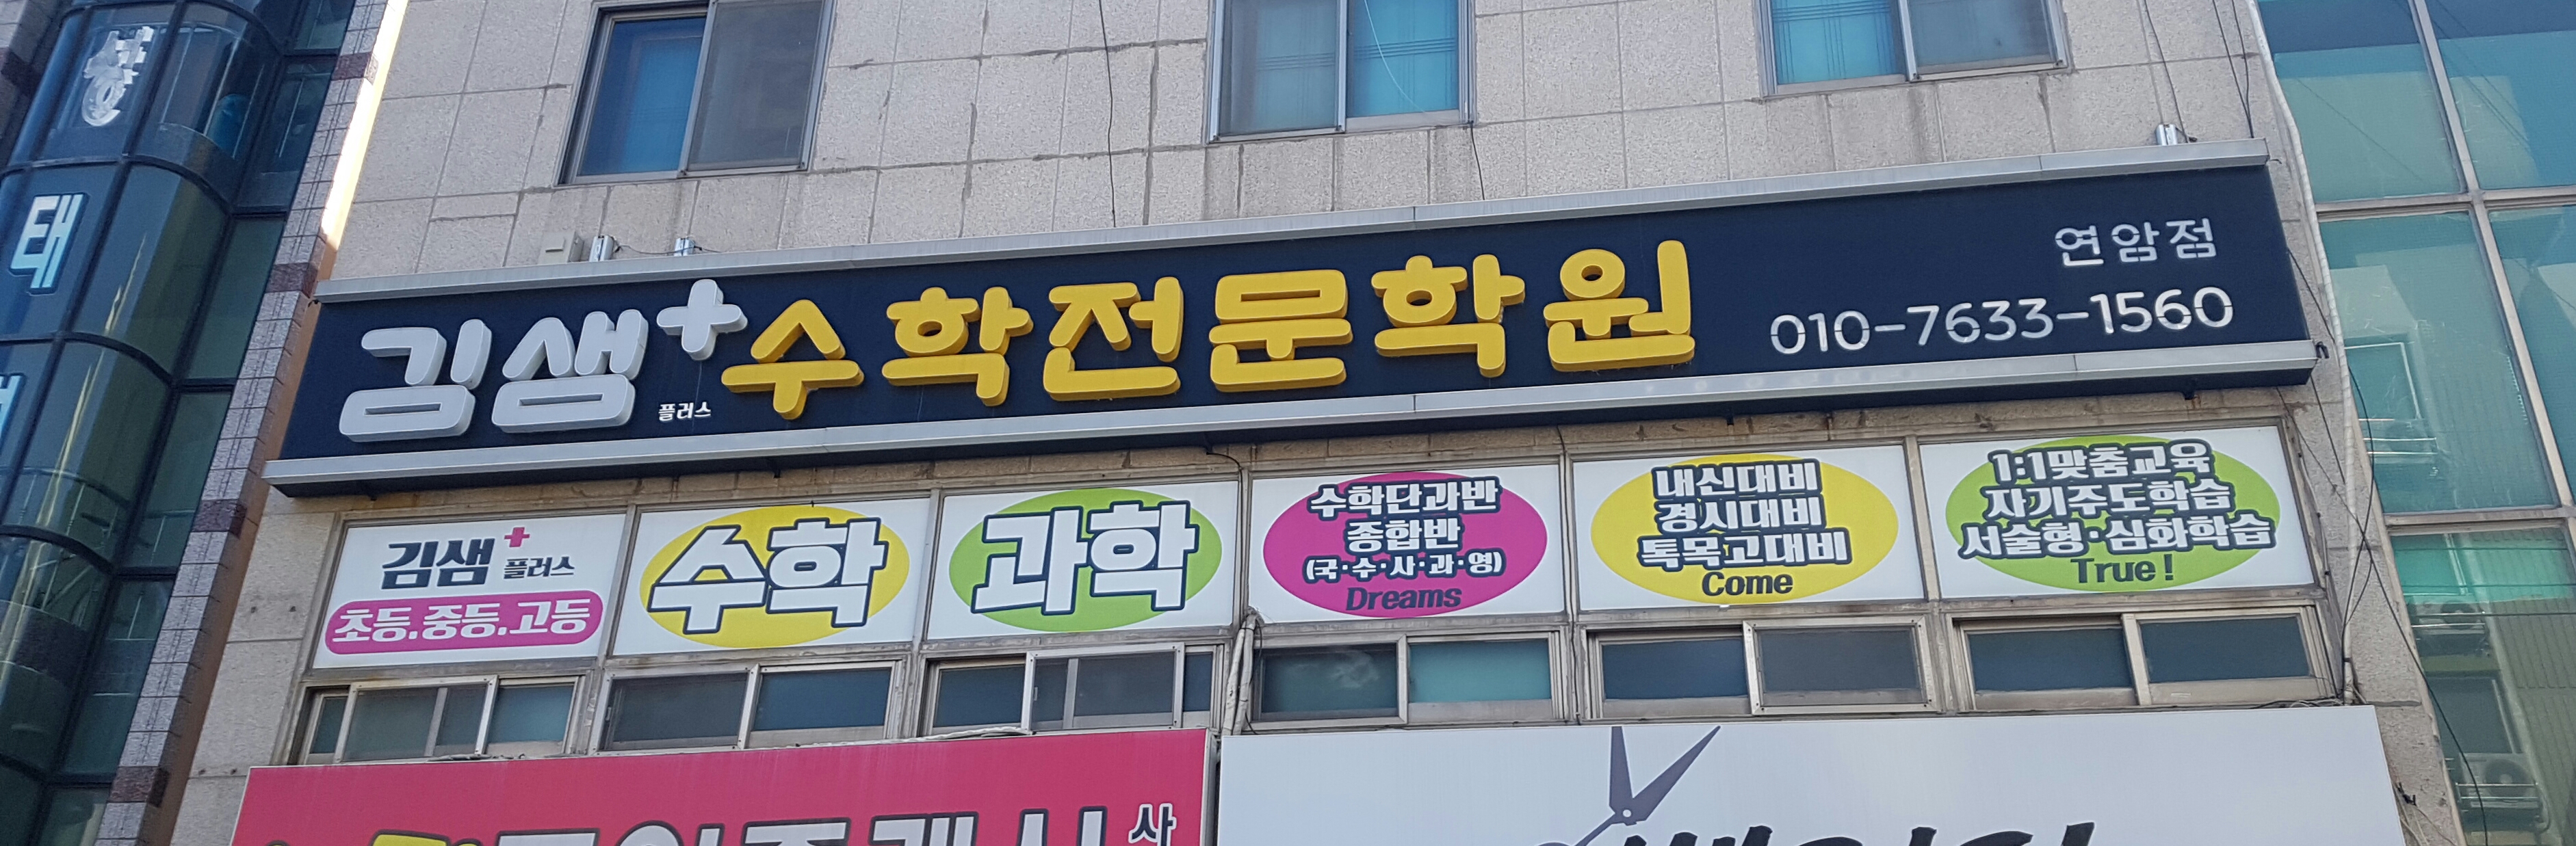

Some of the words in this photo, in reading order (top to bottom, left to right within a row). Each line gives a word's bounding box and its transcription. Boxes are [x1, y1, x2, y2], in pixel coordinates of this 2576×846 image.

[2055, 217, 2217, 267] 연암점
[1770, 287, 2233, 355] 010-7633-1560
[658, 401, 711, 421] 플러스
[1655, 462, 1819, 497] 내신대비
[1992, 441, 2211, 481] 1:1맞춤교육
[1310, 479, 1499, 518] 수학단과반
[1657, 497, 1822, 533] 경시대비
[1985, 479, 2230, 517] 자기주도학습
[1347, 517, 1461, 553] 종합반
[1962, 514, 2271, 555] 서술형·심화학습
[380, 538, 495, 590] 김샘
[504, 556, 575, 579] 플러스
[647, 516, 889, 635] 수학
[971, 500, 1199, 616] 과학
[1345, 587, 1462, 611] Dreams
[1702, 570, 1794, 596] Come
